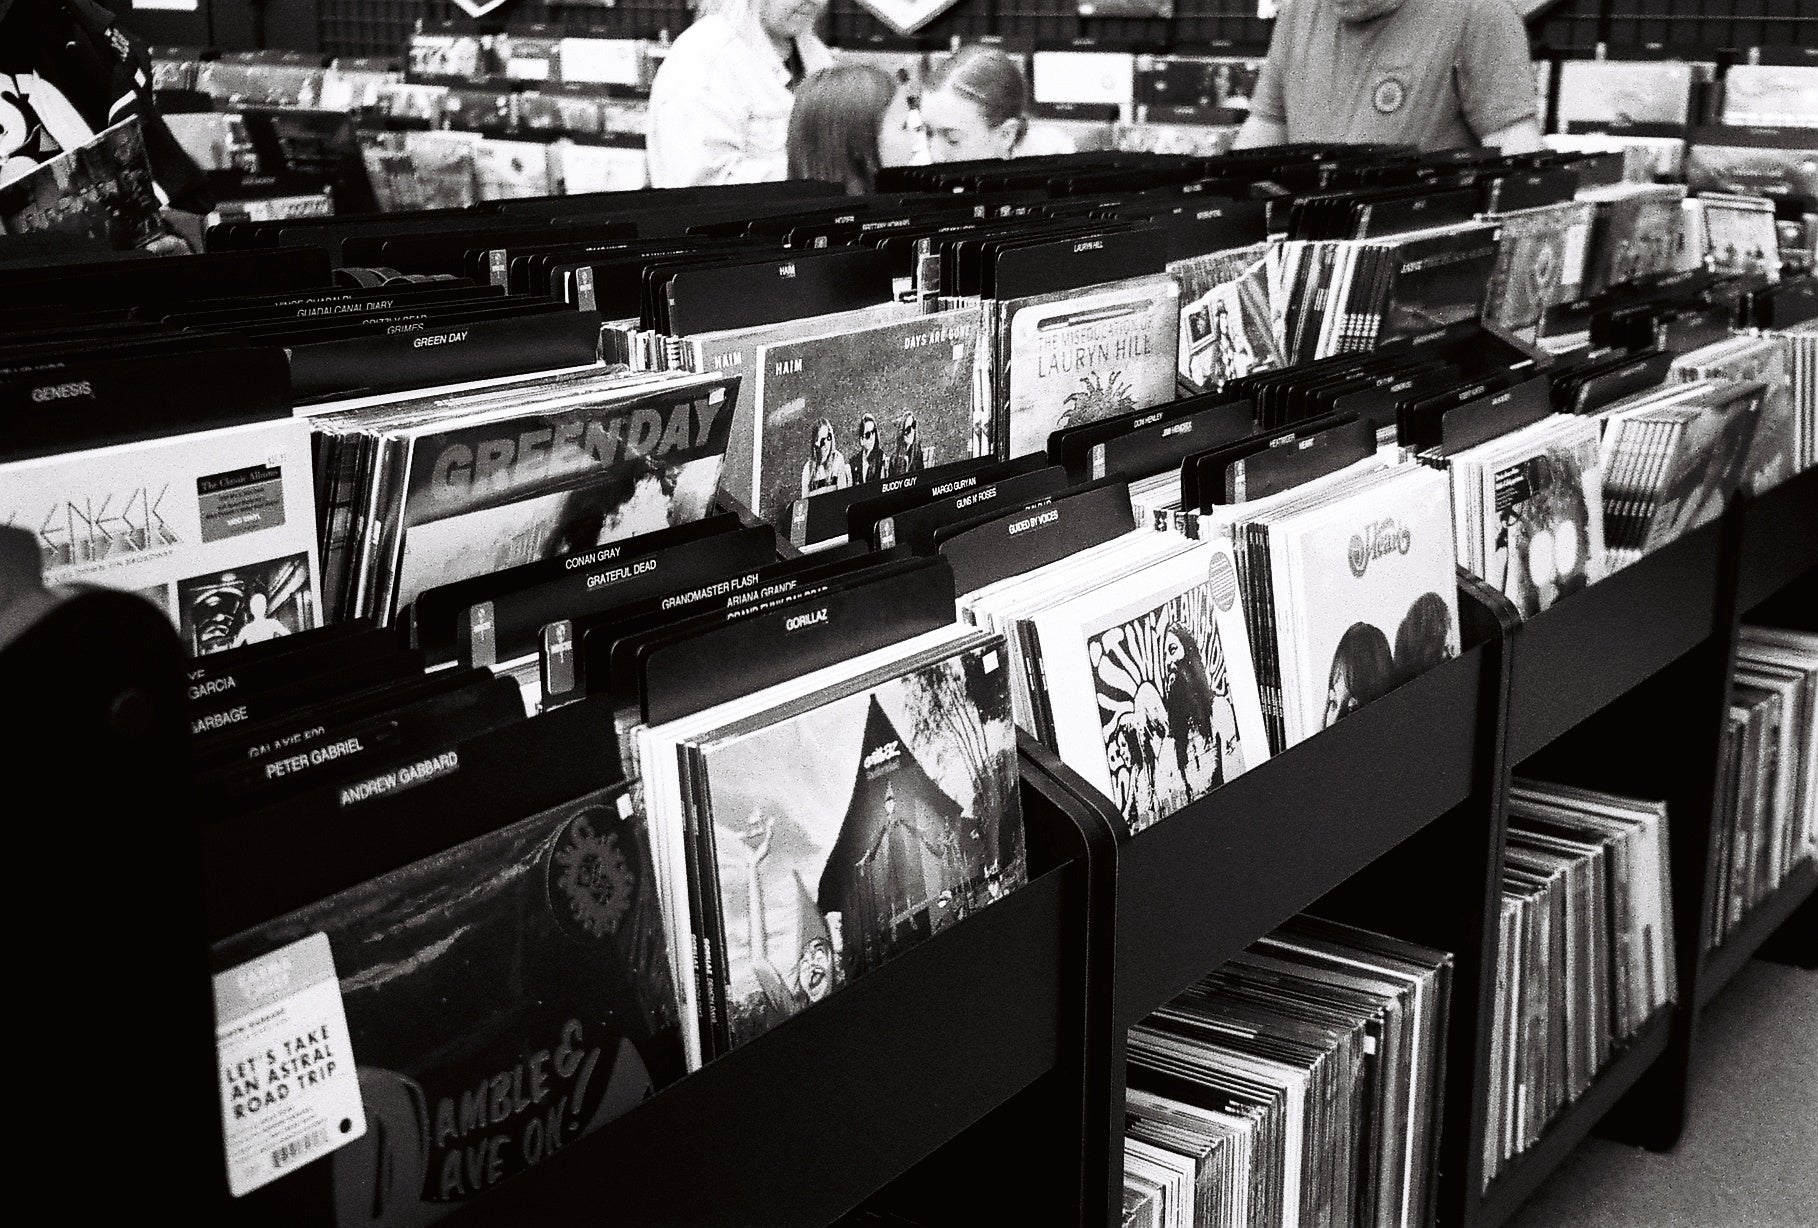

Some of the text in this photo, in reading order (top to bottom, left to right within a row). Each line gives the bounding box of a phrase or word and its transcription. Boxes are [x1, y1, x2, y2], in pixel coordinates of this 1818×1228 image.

[779, 264, 796, 277] HAIM
[366, 299, 395, 311] DIARY
[387, 322, 425, 335] GRIMES
[413, 331, 468, 349] GREEN DAY
[904, 333, 927, 350] DAYS
[929, 329, 946, 345] ARE
[714, 351, 743, 370] HAIM
[775, 358, 804, 376] HAIM
[1038, 333, 1151, 378] LAURYN HILL
[31, 381, 93, 402] GENESIS
[431, 393, 726, 487] GREEN DAY
[881, 475, 918, 494] BUDDY GUY
[932, 476, 977, 497] MARGO GURYAN
[956, 495, 973, 509] GUNS
[978, 487, 997, 502] ROSES
[1008, 519, 1031, 535] GUIDED
[1038, 509, 1059, 525] VOICES
[565, 547, 622, 571] CONAN GRAY
[587, 559, 657, 589] GRATEFUL DEAD
[661, 573, 759, 610] GRANDMASTER FLASH
[726, 590, 760, 609] ARIANA
[760, 580, 798, 599] GRANDE
[785, 608, 828, 631] GORILLAZ
[188, 676, 236, 700] GARCIA
[265, 738, 364, 779] PETER GABRIEL
[341, 751, 459, 806] ANDREW GABBARD
[226, 1050, 276, 1084] LET'S
[284, 1025, 330, 1057] TAKE
[230, 1045, 334, 1101] AN ASTRAL
[234, 1061, 337, 1120] ROAD TRIP
